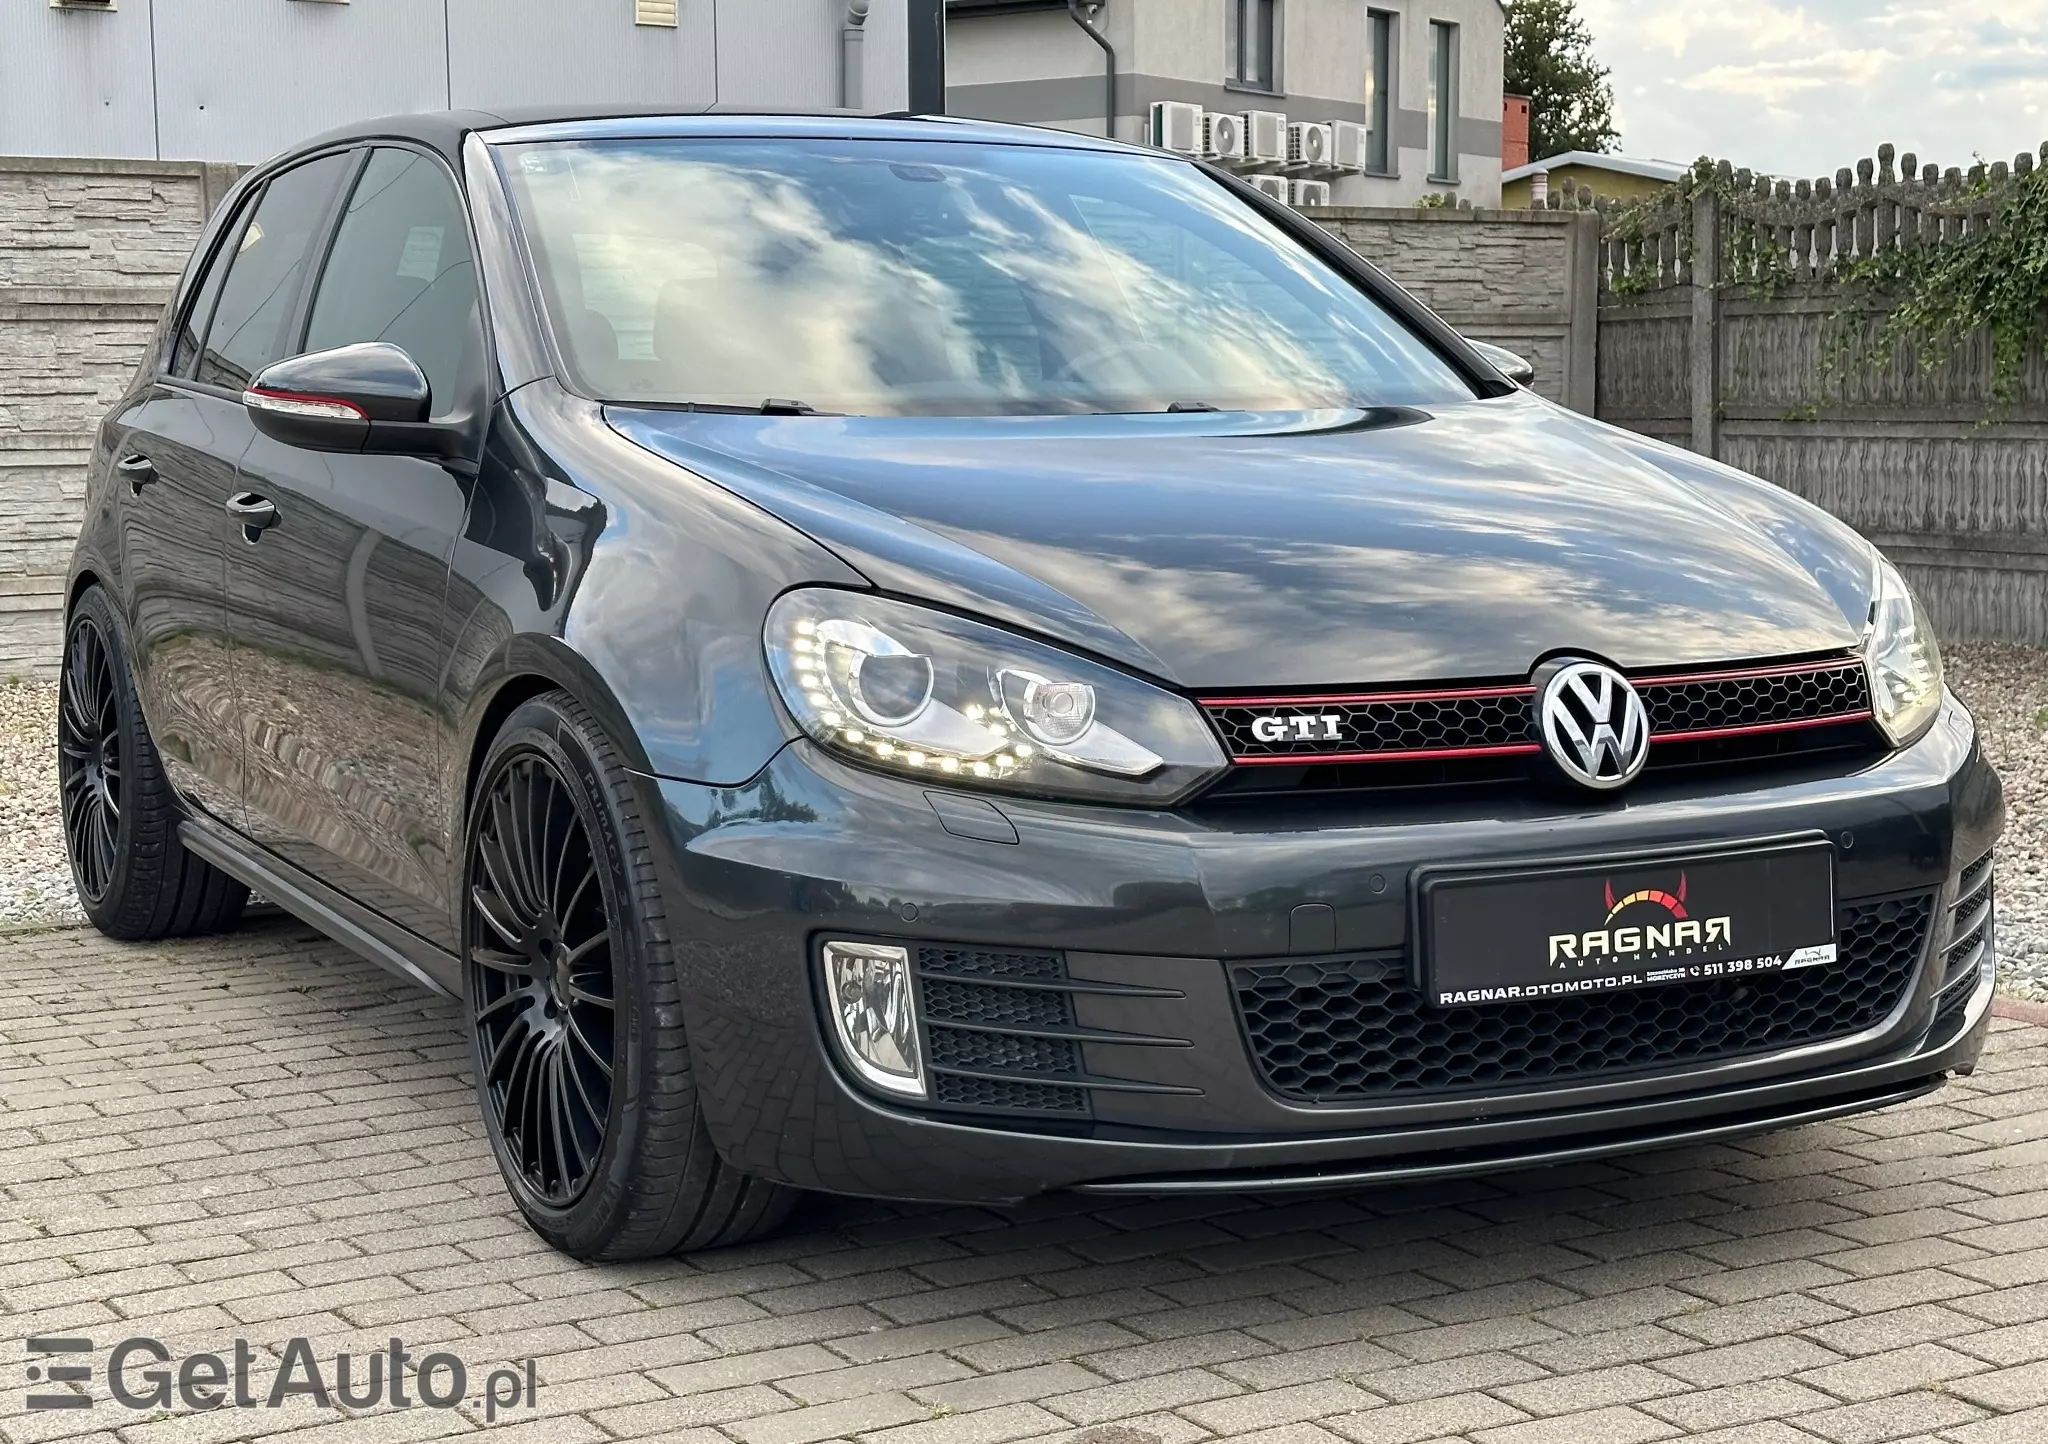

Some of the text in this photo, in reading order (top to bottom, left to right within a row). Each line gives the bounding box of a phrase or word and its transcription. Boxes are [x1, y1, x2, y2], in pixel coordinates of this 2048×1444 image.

[1251, 714, 1343, 743] GTI
[1550, 670, 1640, 779] VW
[1559, 943, 1723, 969] AUTO HANDEL
[1703, 955, 1783, 976] 511 398 504
[1439, 974, 1643, 1004] RAGNAR.OTOMOTO.PL
